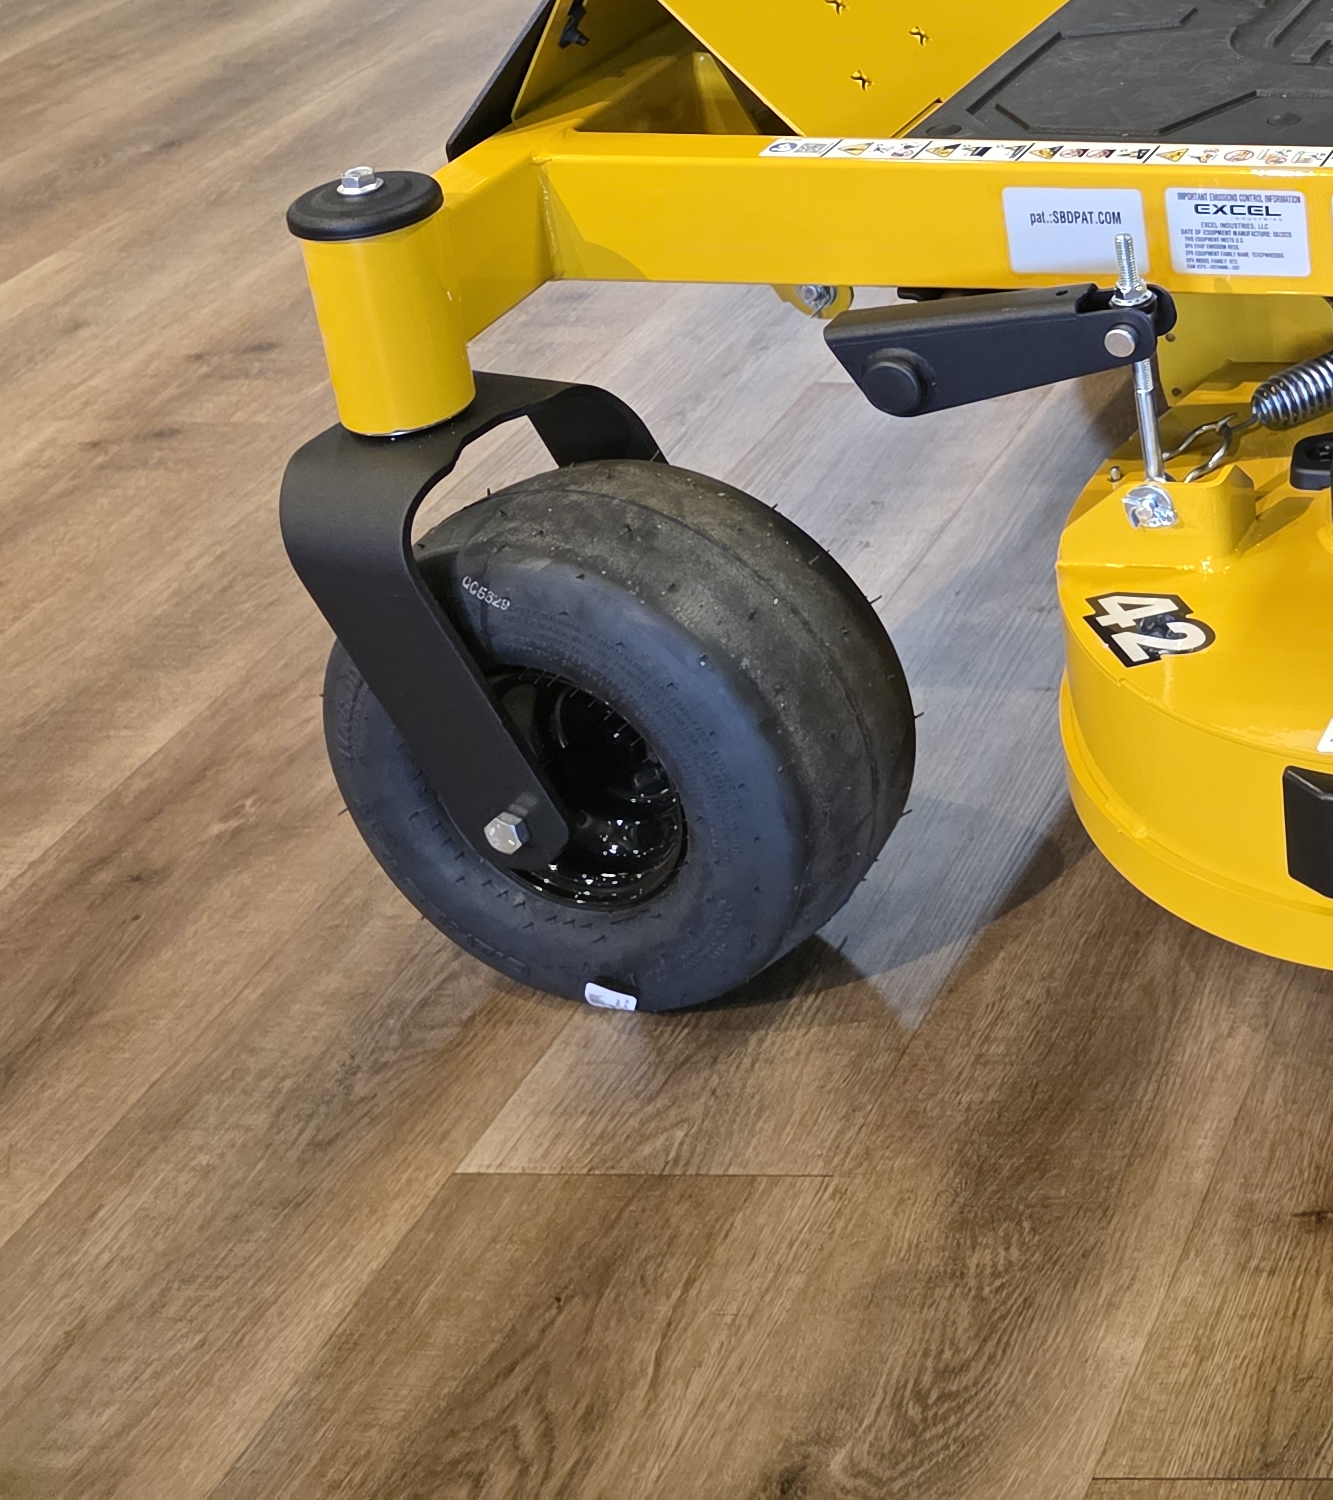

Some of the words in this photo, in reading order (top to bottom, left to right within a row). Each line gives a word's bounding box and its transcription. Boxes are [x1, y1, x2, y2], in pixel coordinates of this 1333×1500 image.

[1177, 192, 1208, 201] IMPORTANT
[1239, 193, 1263, 203] CONTROL
[1264, 194, 1301, 204] INFORMATION
[1194, 203, 1282, 217] EXCEL
[1090, 593, 1210, 665] 42
